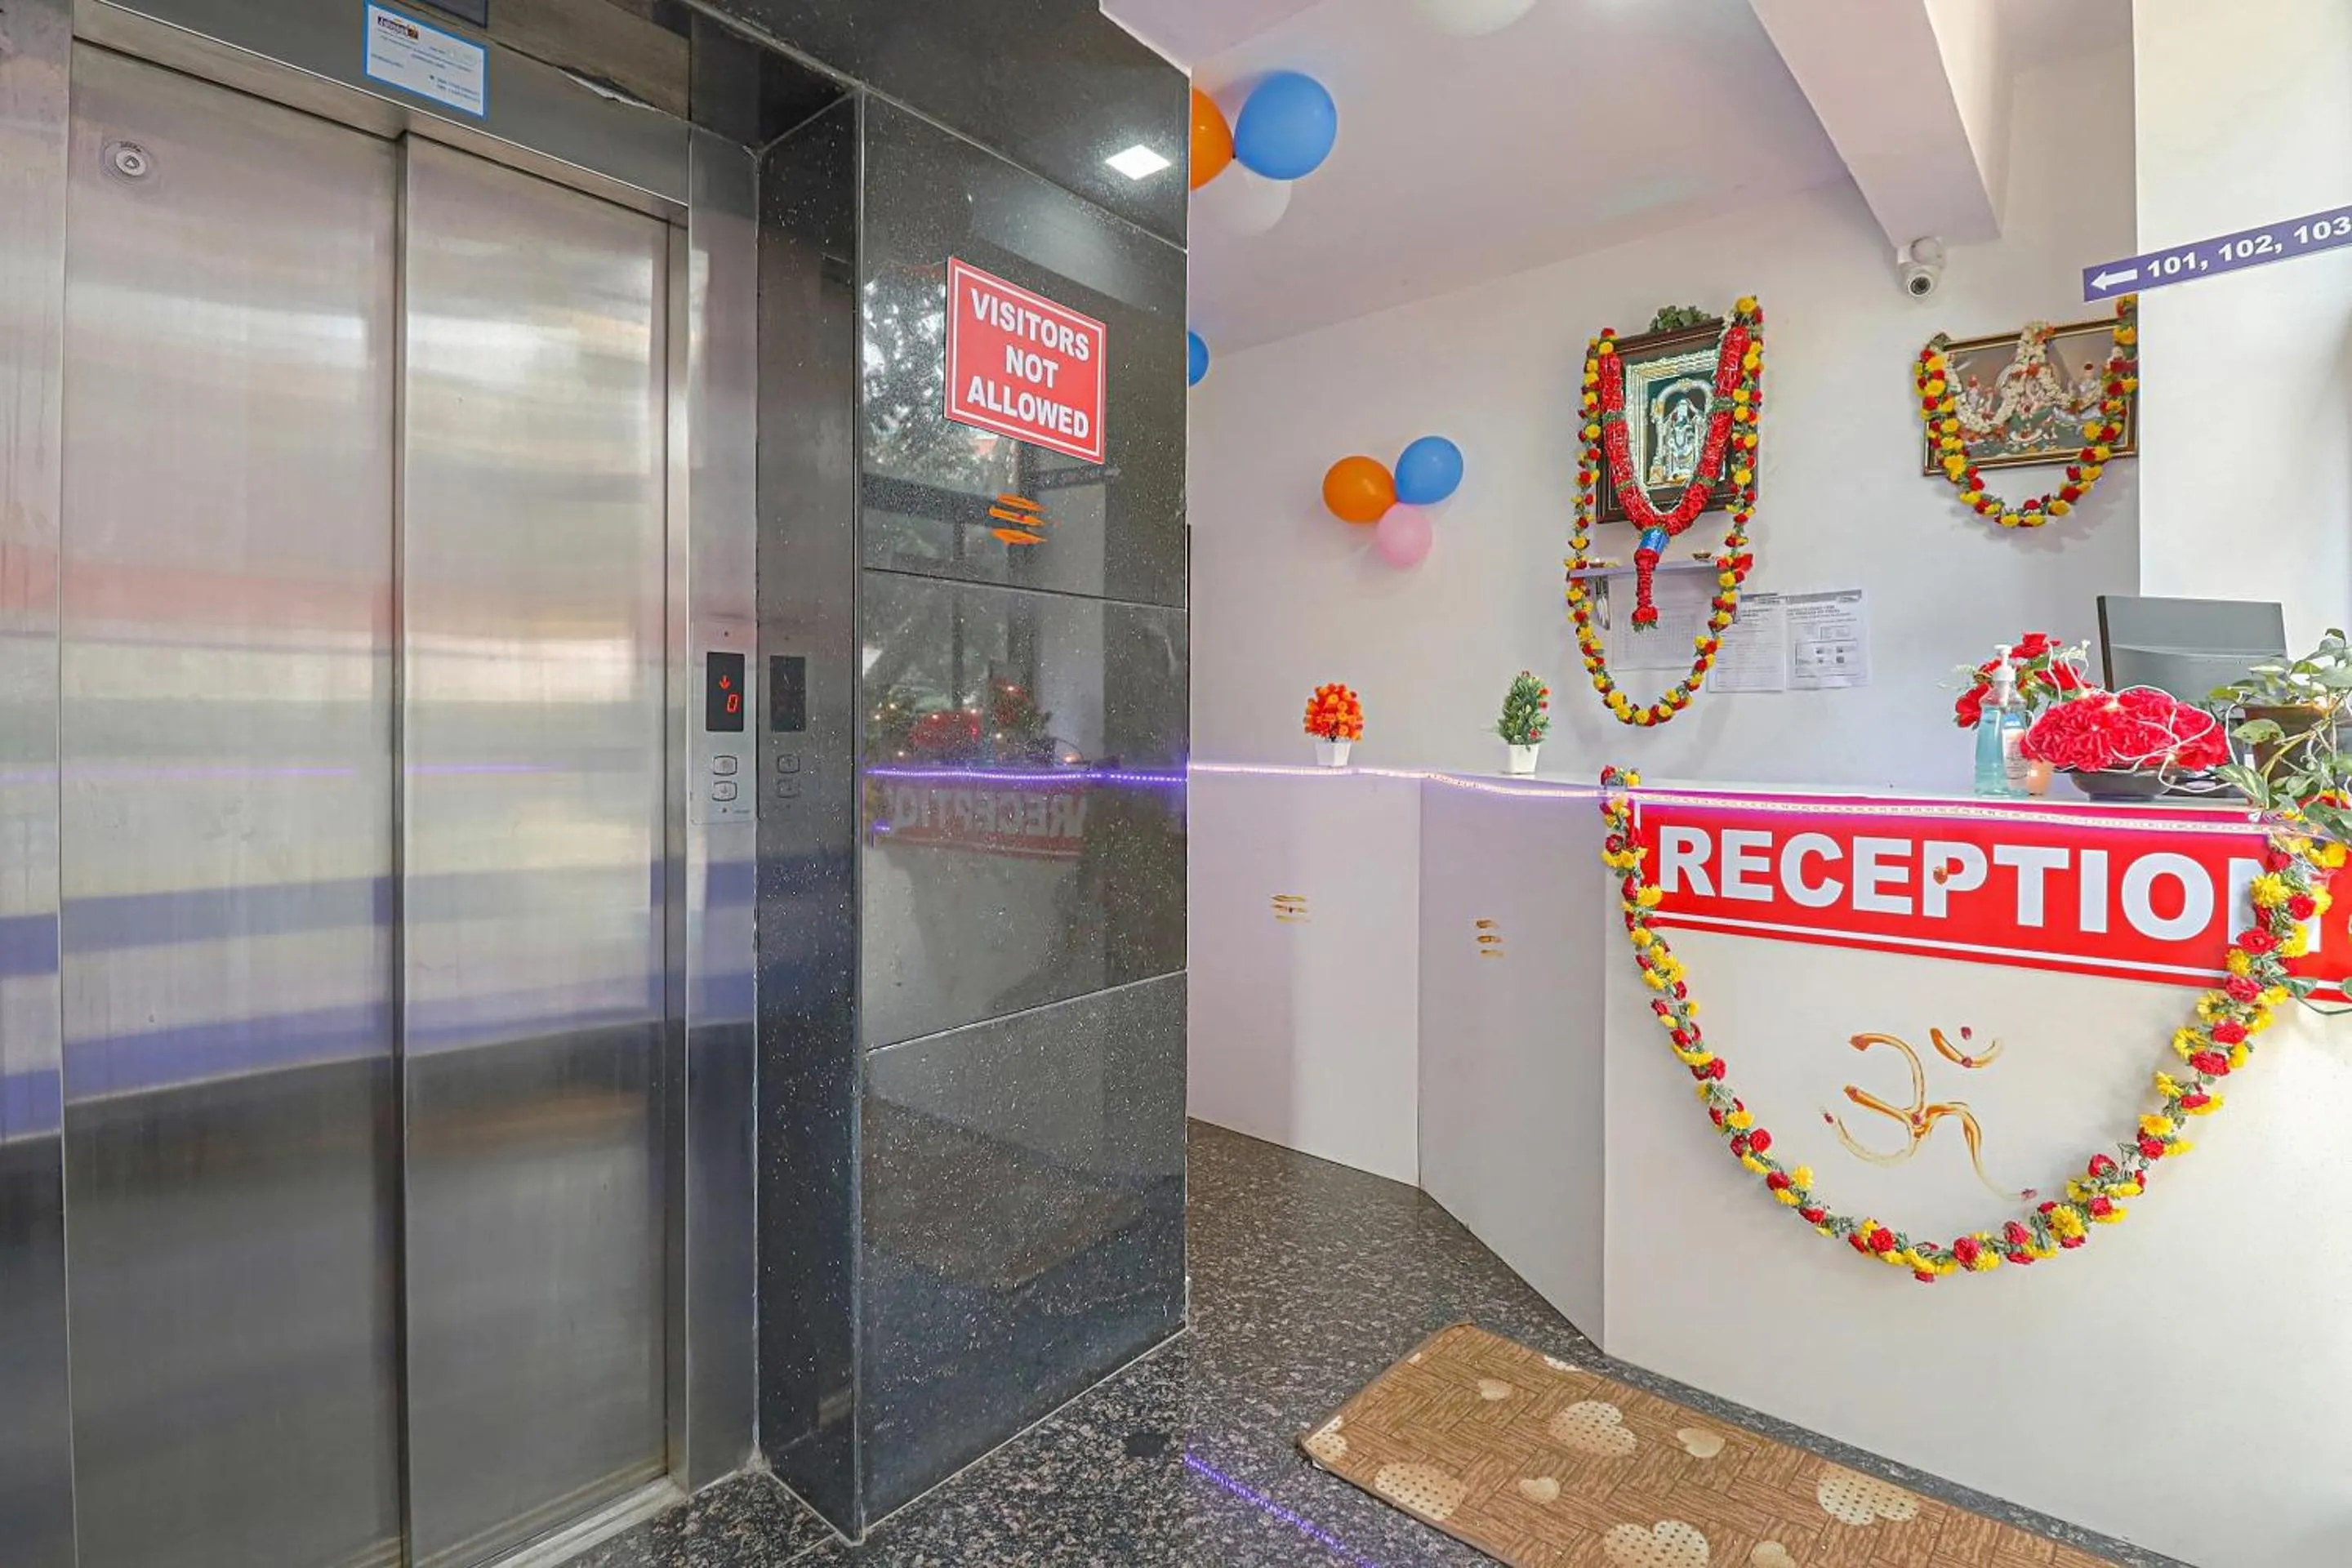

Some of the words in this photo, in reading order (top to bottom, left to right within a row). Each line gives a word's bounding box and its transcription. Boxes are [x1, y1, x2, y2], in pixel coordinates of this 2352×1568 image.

[2147, 252, 2208, 278] 101,
[2218, 234, 2283, 262] 102,
[2293, 215, 2352, 244] 103
[969, 287, 1090, 362] VISITORS
[1005, 345, 1059, 390] NOT
[966, 375, 1090, 439] ALLOWED
[726, 693, 739, 712] 0
